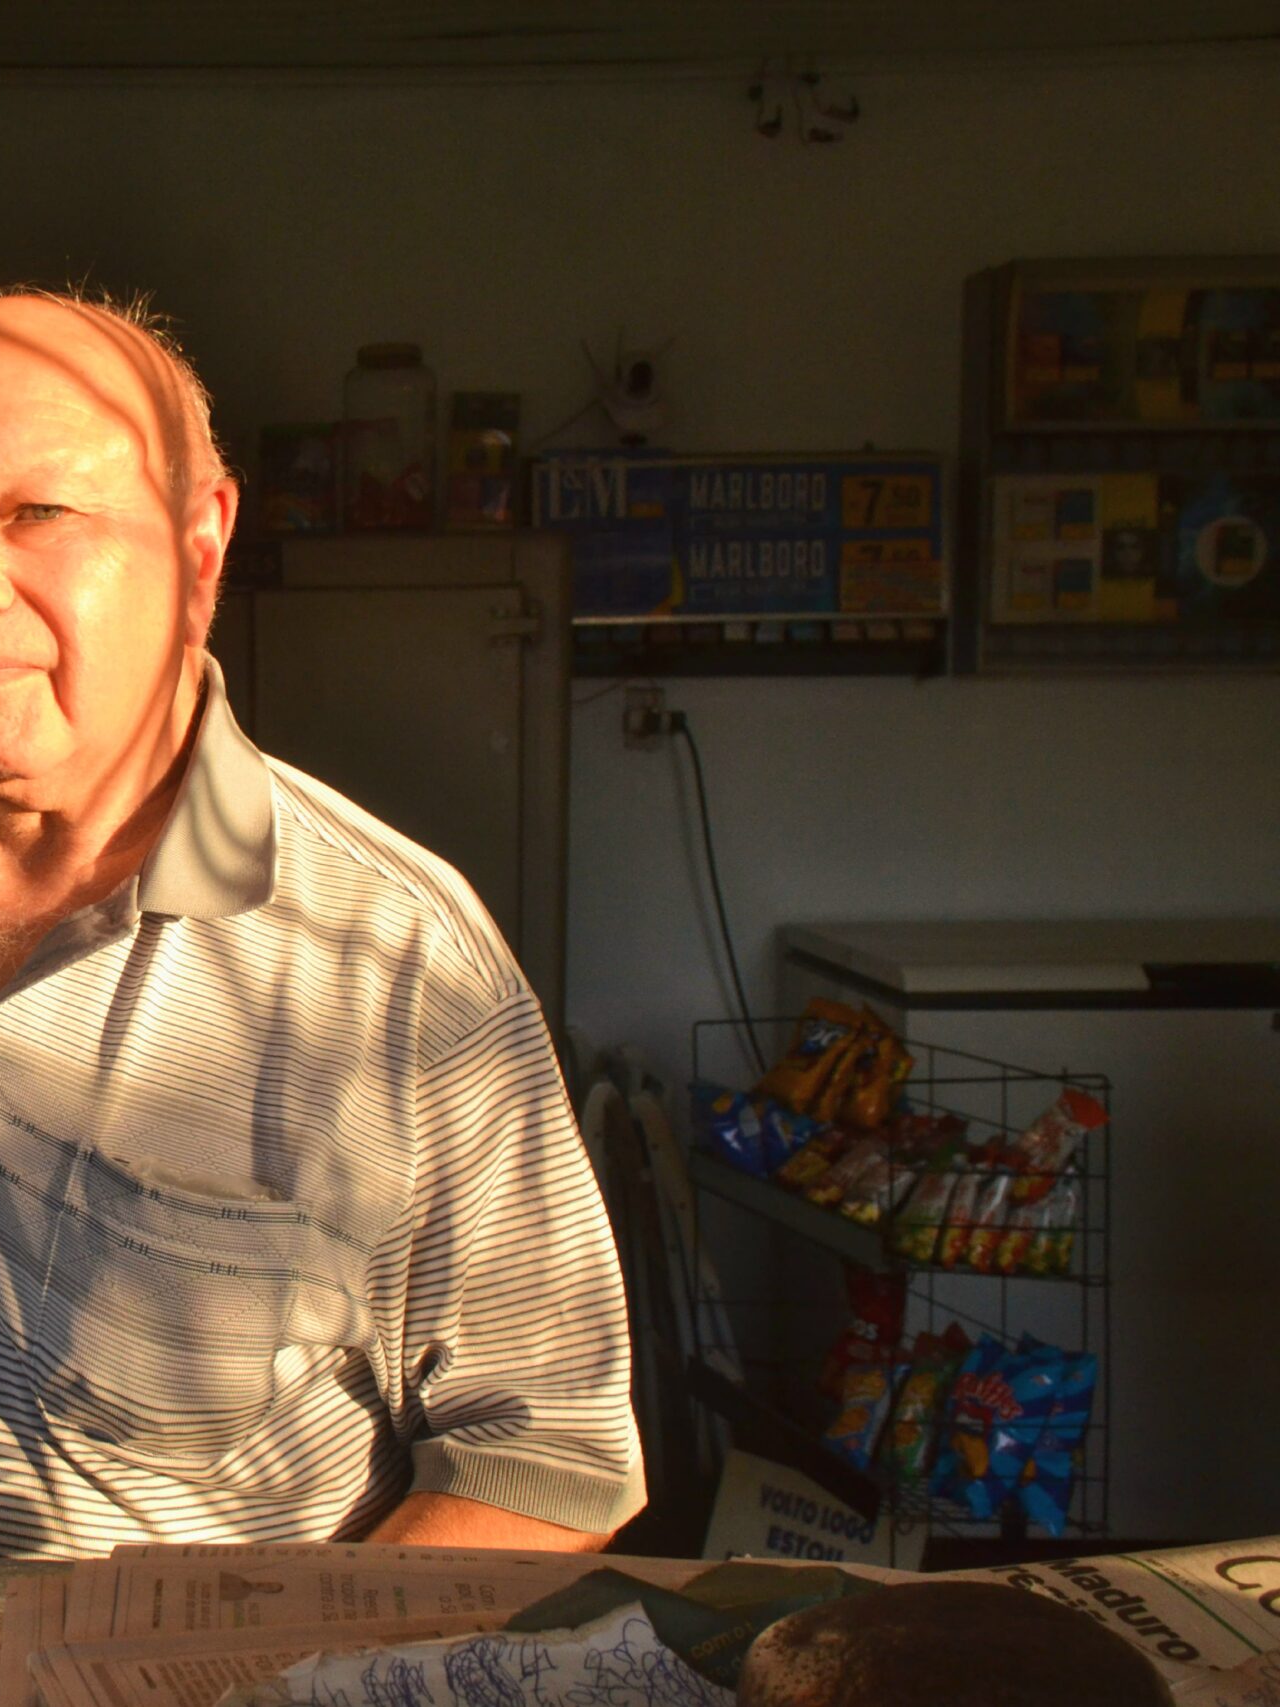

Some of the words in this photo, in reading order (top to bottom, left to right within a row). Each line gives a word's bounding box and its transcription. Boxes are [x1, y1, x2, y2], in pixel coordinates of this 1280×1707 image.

[689, 472, 827, 510] MARLBORO
[688, 539, 827, 578] MARLBORO
[1040, 1559, 1201, 1661] Maduro
